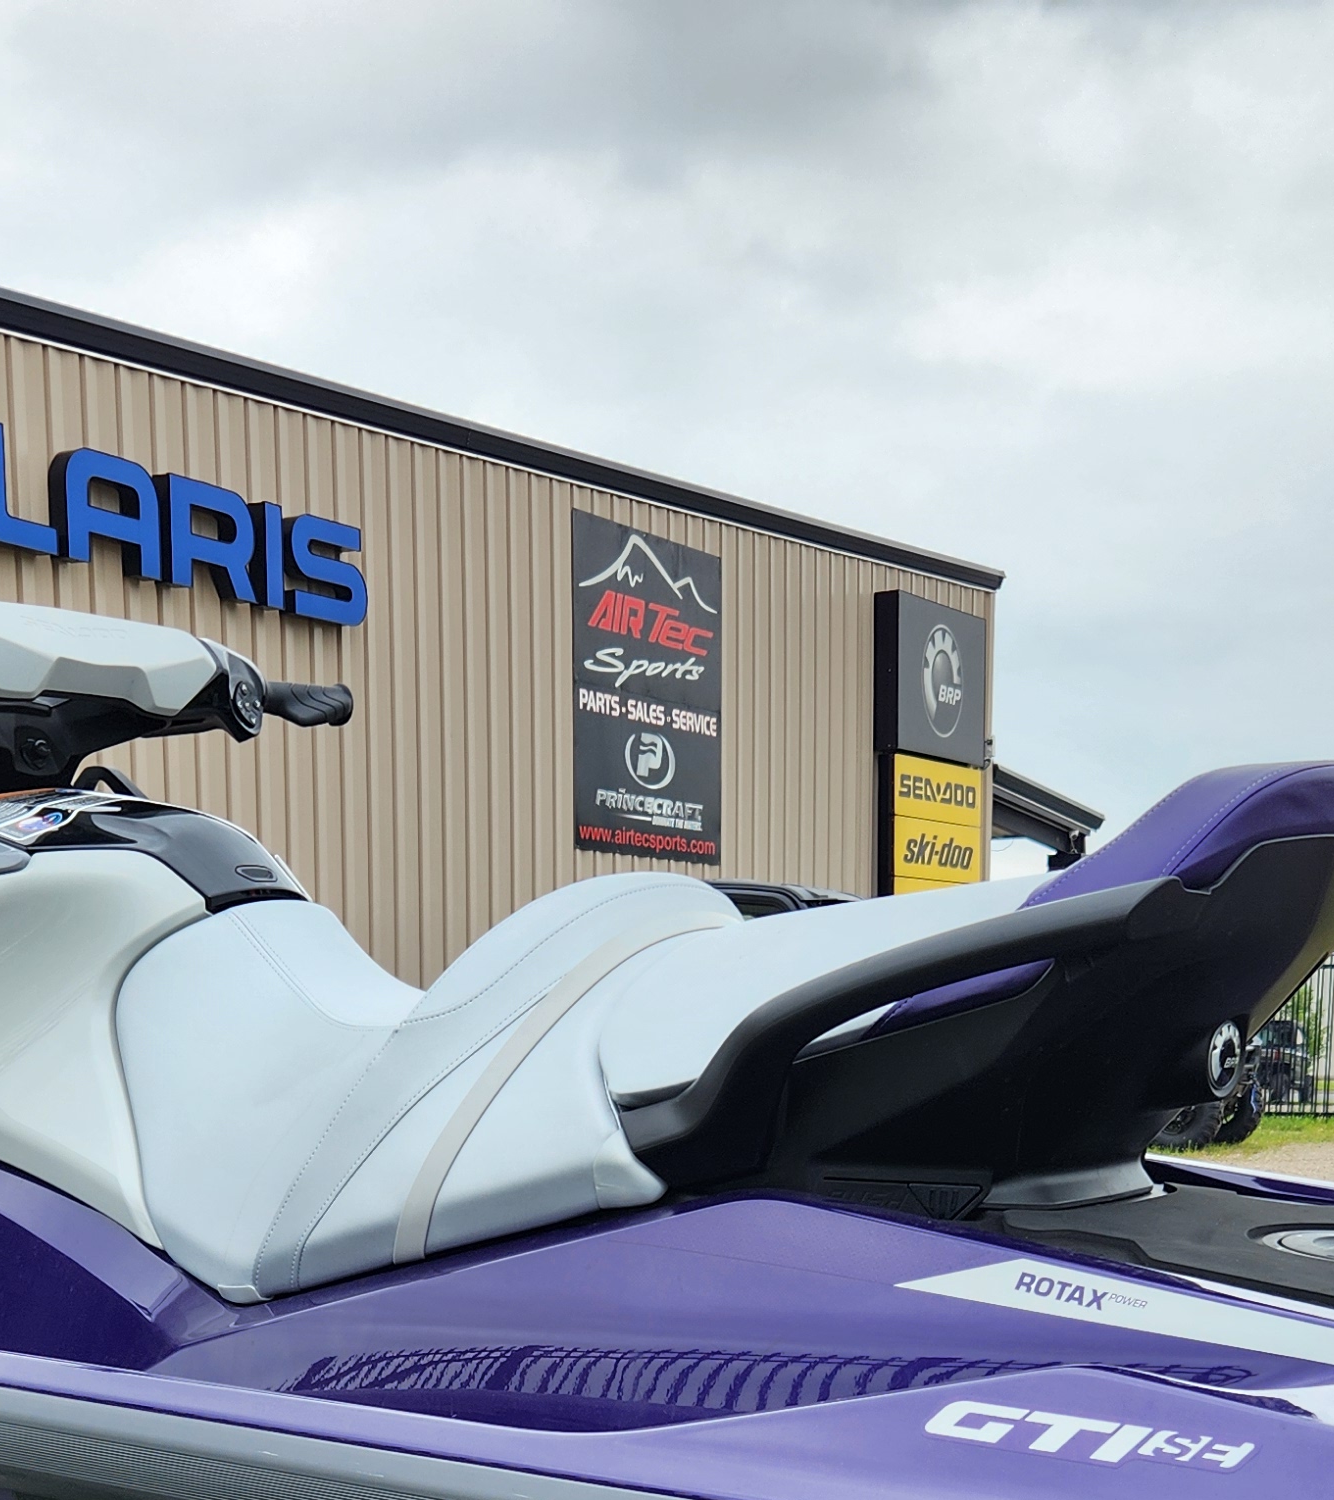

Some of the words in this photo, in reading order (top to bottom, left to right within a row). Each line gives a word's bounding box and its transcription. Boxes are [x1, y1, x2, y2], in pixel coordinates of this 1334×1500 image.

[584, 648, 705, 687] Sports
[579, 688, 620, 717] PARTS
[627, 699, 665, 726] SALES
[672, 708, 717, 737] SERVICE
[938, 684, 961, 706] BRP
[595, 789, 703, 821] PRINCECRAFT
[579, 826, 716, 855] www.airtecsports.com
[903, 833, 973, 870] ski-doo
[1015, 1272, 1108, 1311] ROTAX
[1108, 1293, 1148, 1309] POWER
[924, 1400, 1154, 1463] GTI
